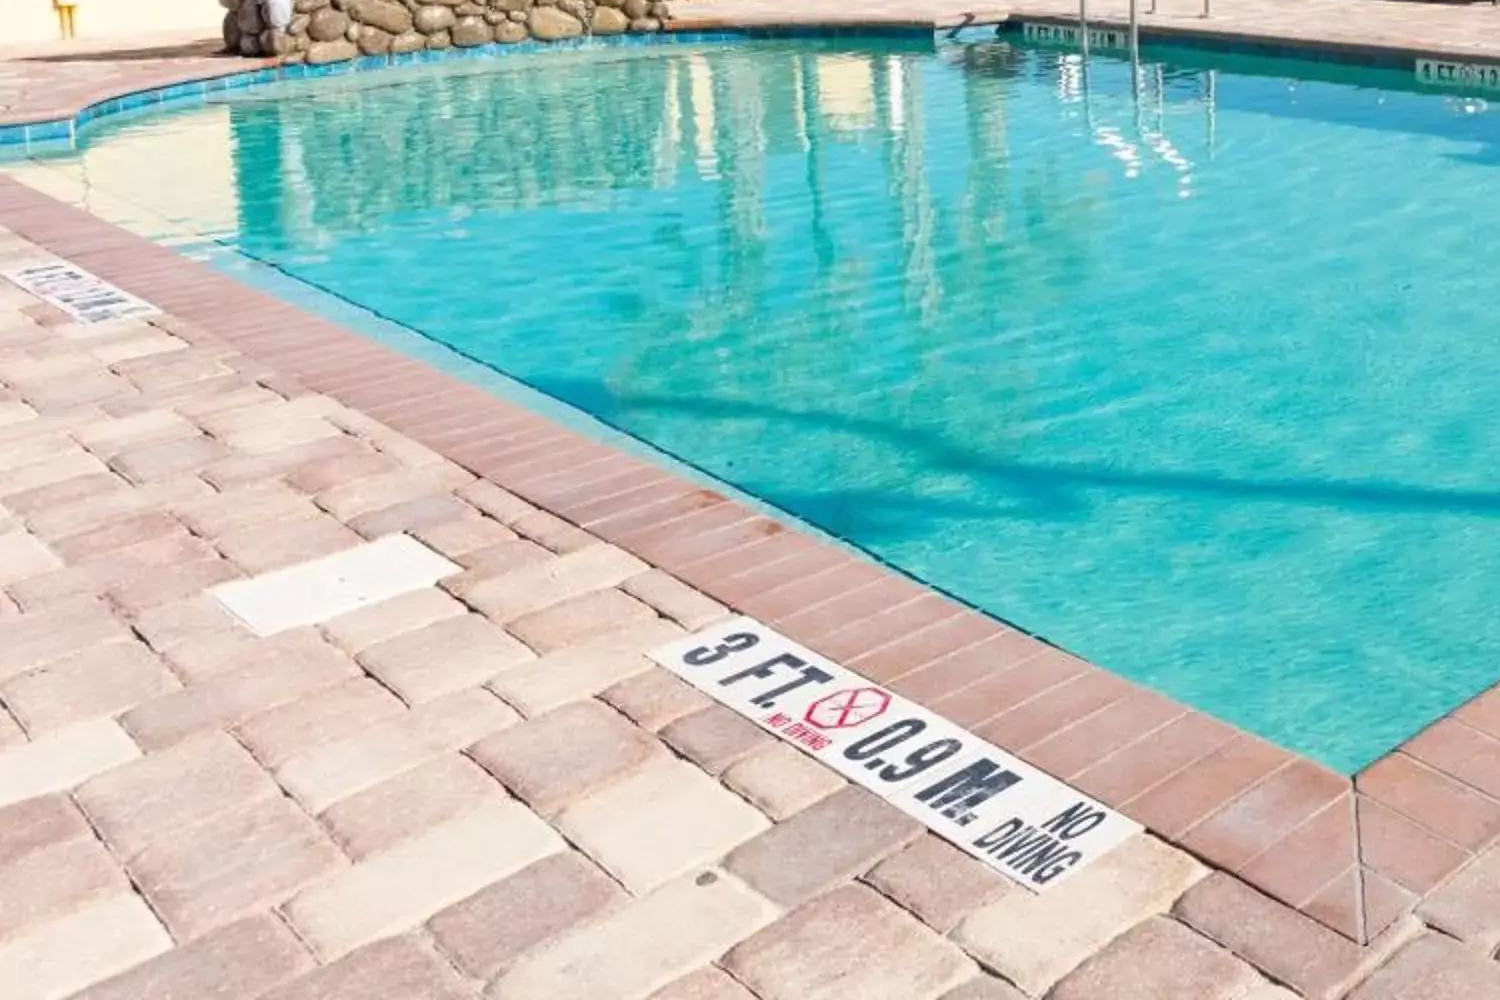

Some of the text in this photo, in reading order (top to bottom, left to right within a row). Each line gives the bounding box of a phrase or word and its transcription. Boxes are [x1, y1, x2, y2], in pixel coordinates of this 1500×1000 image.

[683, 632, 760, 666] 3
[717, 653, 835, 708] FT.
[766, 712, 792, 728] NO
[1040, 801, 1107, 840] NO
[972, 817, 1082, 884] DIVING
